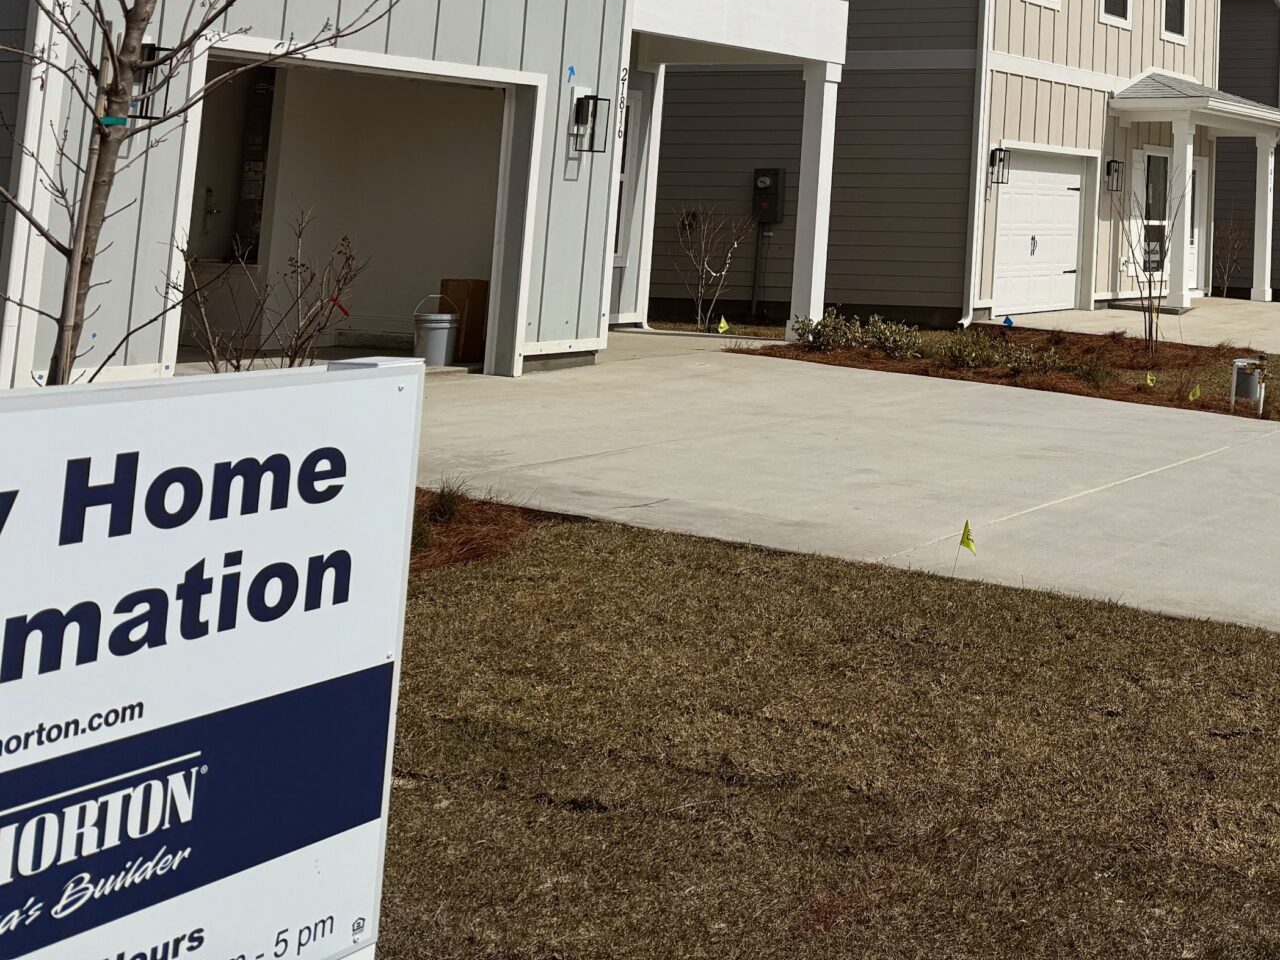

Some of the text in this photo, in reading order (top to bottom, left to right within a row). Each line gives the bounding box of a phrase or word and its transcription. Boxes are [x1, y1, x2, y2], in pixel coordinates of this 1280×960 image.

[58, 446, 348, 546] Home
[0, 548, 353, 684] mation
[0, 701, 144, 756] orton.com
[51, 845, 191, 919] Builder
[273, 928, 289, 959] 5
[297, 915, 335, 956] pm
